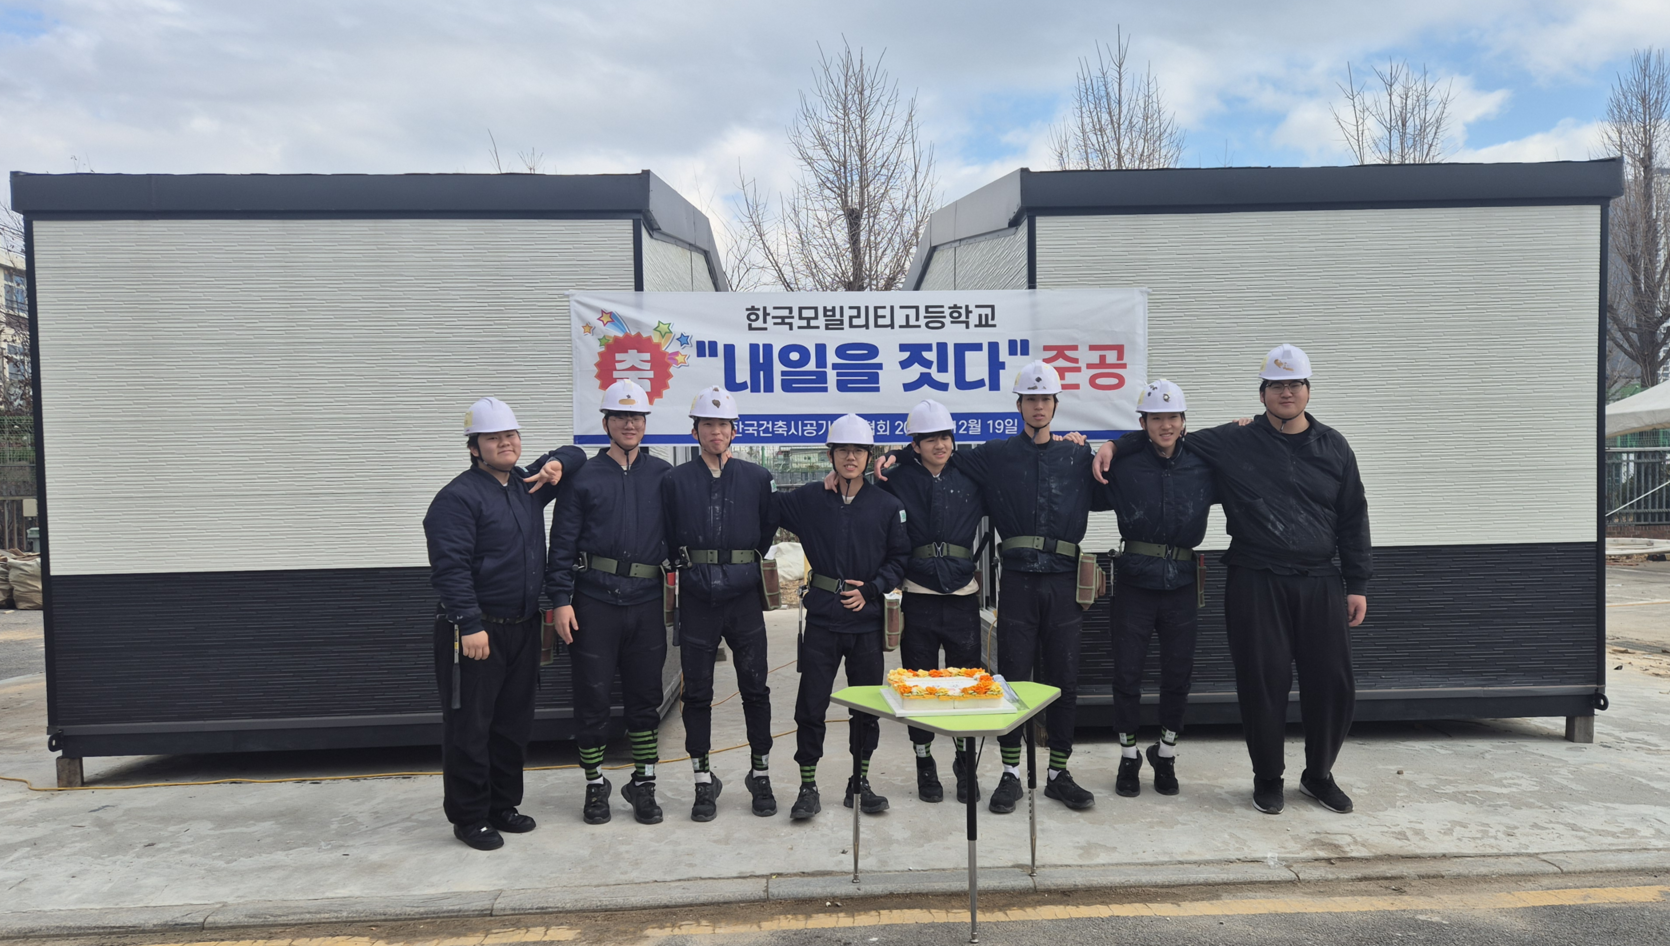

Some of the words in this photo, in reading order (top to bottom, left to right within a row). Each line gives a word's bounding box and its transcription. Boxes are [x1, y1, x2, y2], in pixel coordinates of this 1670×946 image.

[745, 304, 997, 331] 한국모빌리티고등학교
[612, 349, 655, 393] 축
[695, 340, 884, 393] "내일을
[898, 338, 1030, 393] 짓다"
[1041, 344, 1128, 391] 준공
[986, 418, 1018, 435] 19일
